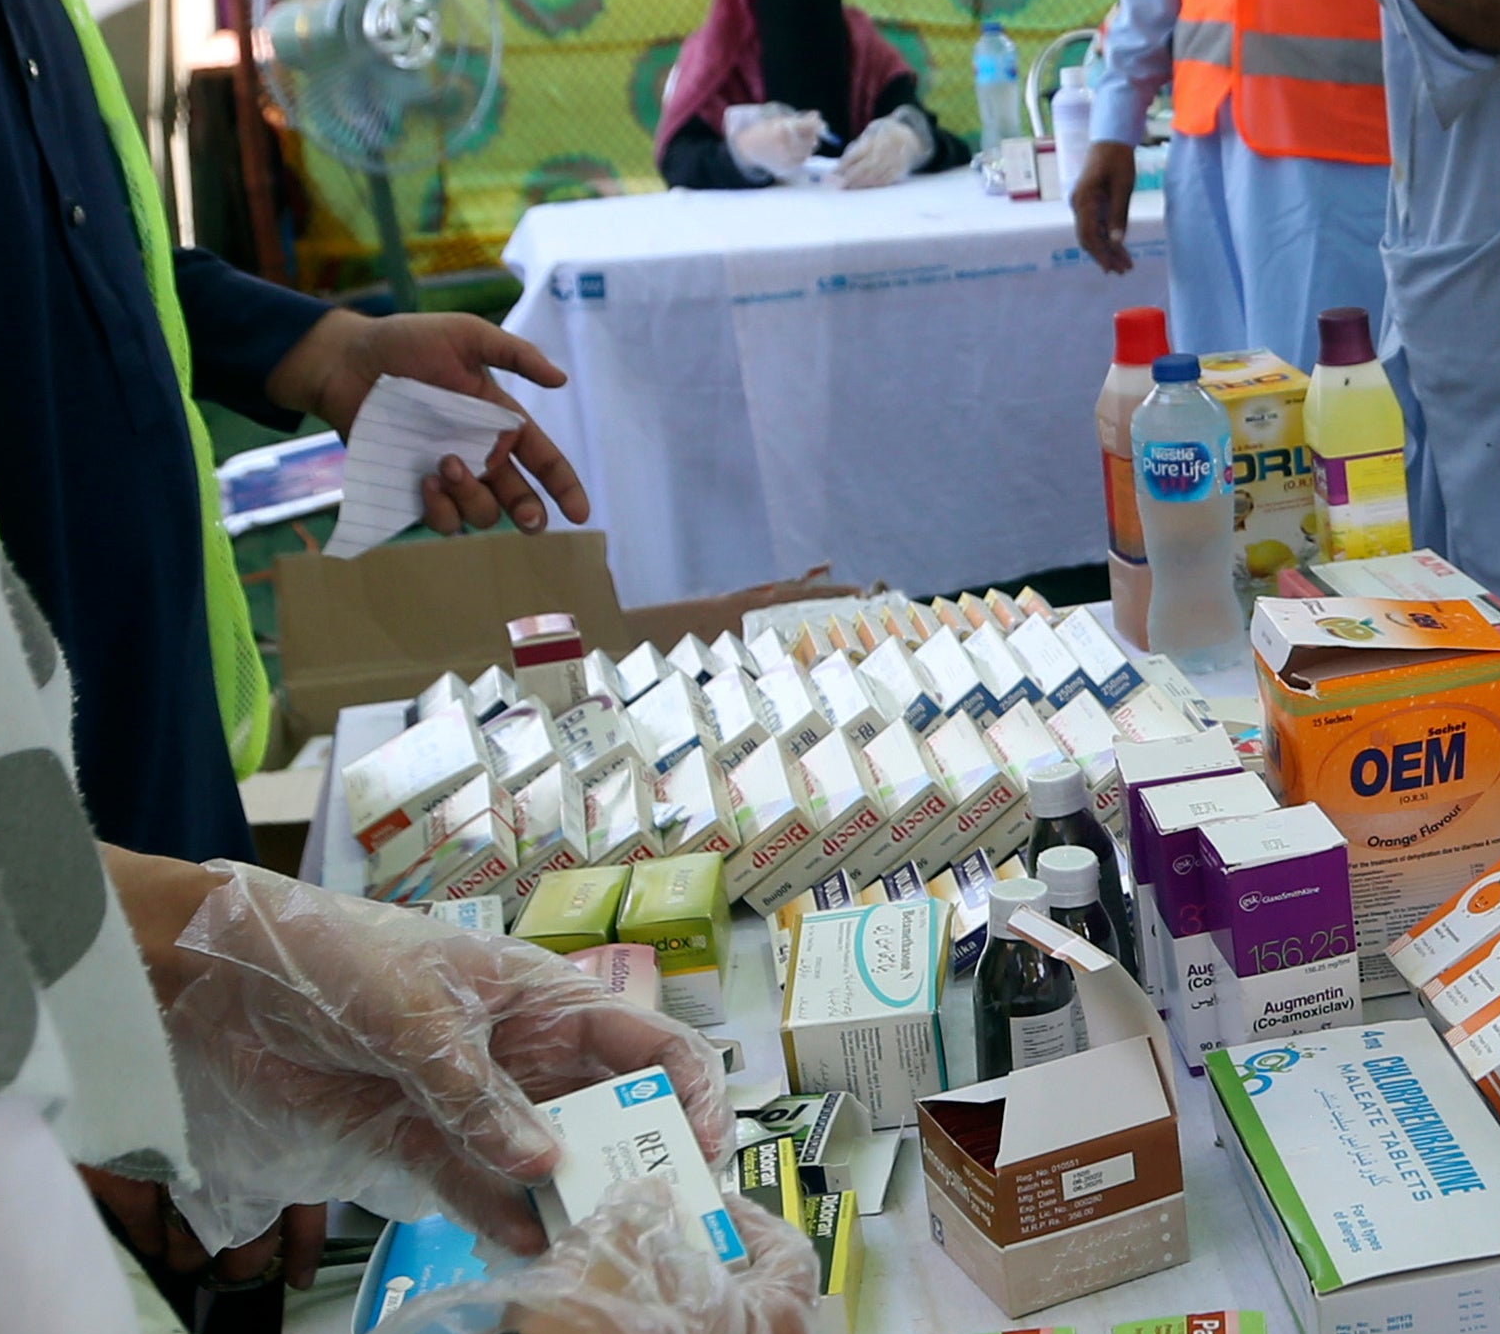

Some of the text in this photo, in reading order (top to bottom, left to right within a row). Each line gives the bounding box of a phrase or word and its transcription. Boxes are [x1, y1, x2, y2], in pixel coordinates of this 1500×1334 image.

[1142, 458, 1211, 482] Pure Life
[1053, 677, 1086, 701] 250mg
[1101, 671, 1130, 697] 250mg
[1324, 713, 1353, 726] Sachets
[1428, 722, 1467, 737] Sachet
[1350, 731, 1467, 798] OEM
[891, 795, 947, 844] Biocip
[957, 785, 1012, 833] Biocip
[1367, 804, 1463, 849] Orange Flavour
[751, 822, 810, 869] Biocip
[821, 808, 879, 858] Biocip
[446, 858, 507, 900] Biocip
[761, 881, 793, 906] 500mg
[899, 909, 915, 980] Betamethasone N
[1247, 924, 1349, 974] 156.25
[611, 947, 629, 994] MediStop
[1253, 997, 1355, 1032] (Co-amoxiclav)
[1263, 986, 1344, 1015] Augmentin
[1336, 1063, 1433, 1202] MALEATE TABLETS
[1362, 1055, 1486, 1198] CHLORPHENIRAMINE
[632, 1128, 675, 1176] REX
[759, 1142, 776, 1186] Dicloran
[1014, 1171, 1035, 1185] Reg.
[1015, 1180, 1038, 1193] Batch
[1017, 1185, 1055, 1205] Mfg. Date
[817, 1193, 836, 1236] Dicloran
[1018, 1196, 1057, 1215] Exp. Date
[1019, 1212, 1037, 1225] Mfg.
[1332, 1210, 1362, 1254] of allergies
[1349, 1202, 1383, 1253] For all types
